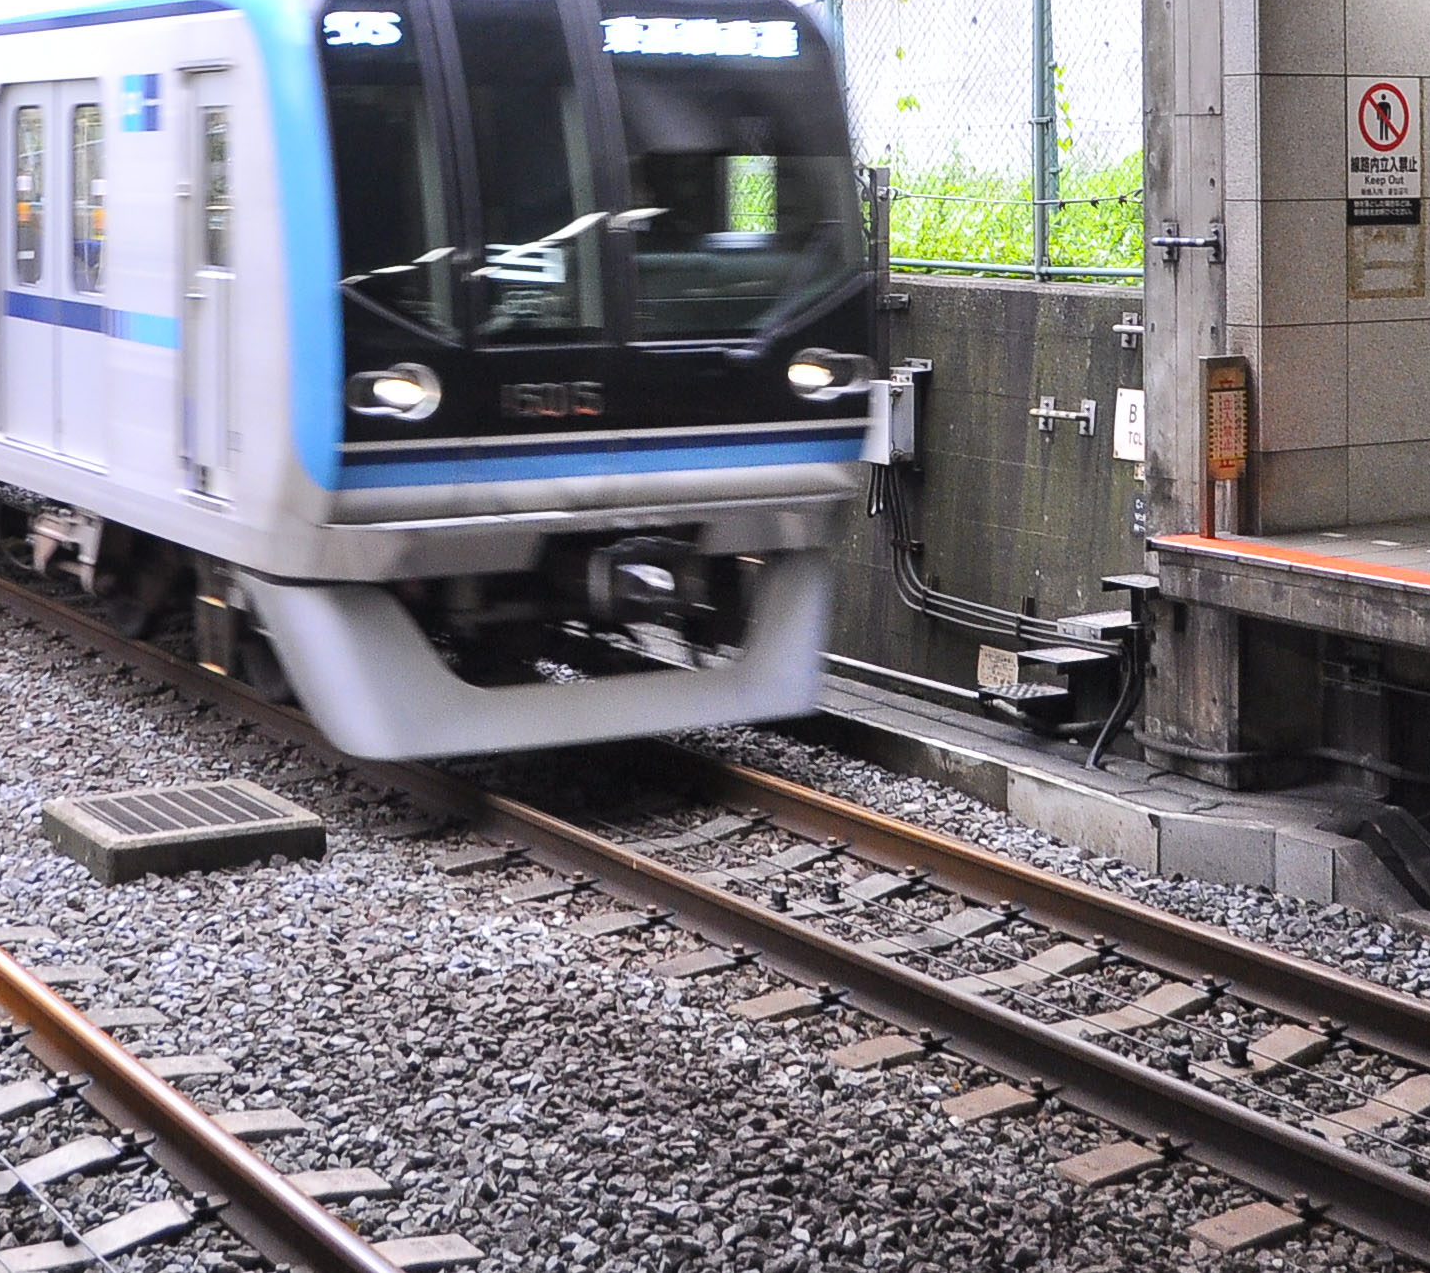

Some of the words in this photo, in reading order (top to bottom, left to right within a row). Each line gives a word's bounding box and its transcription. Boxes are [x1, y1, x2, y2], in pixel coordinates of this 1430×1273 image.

[1350, 156, 1418, 173] 線路内立入禁止
[1364, 175, 1386, 186] Keep
[1388, 175, 1404, 185] Out
